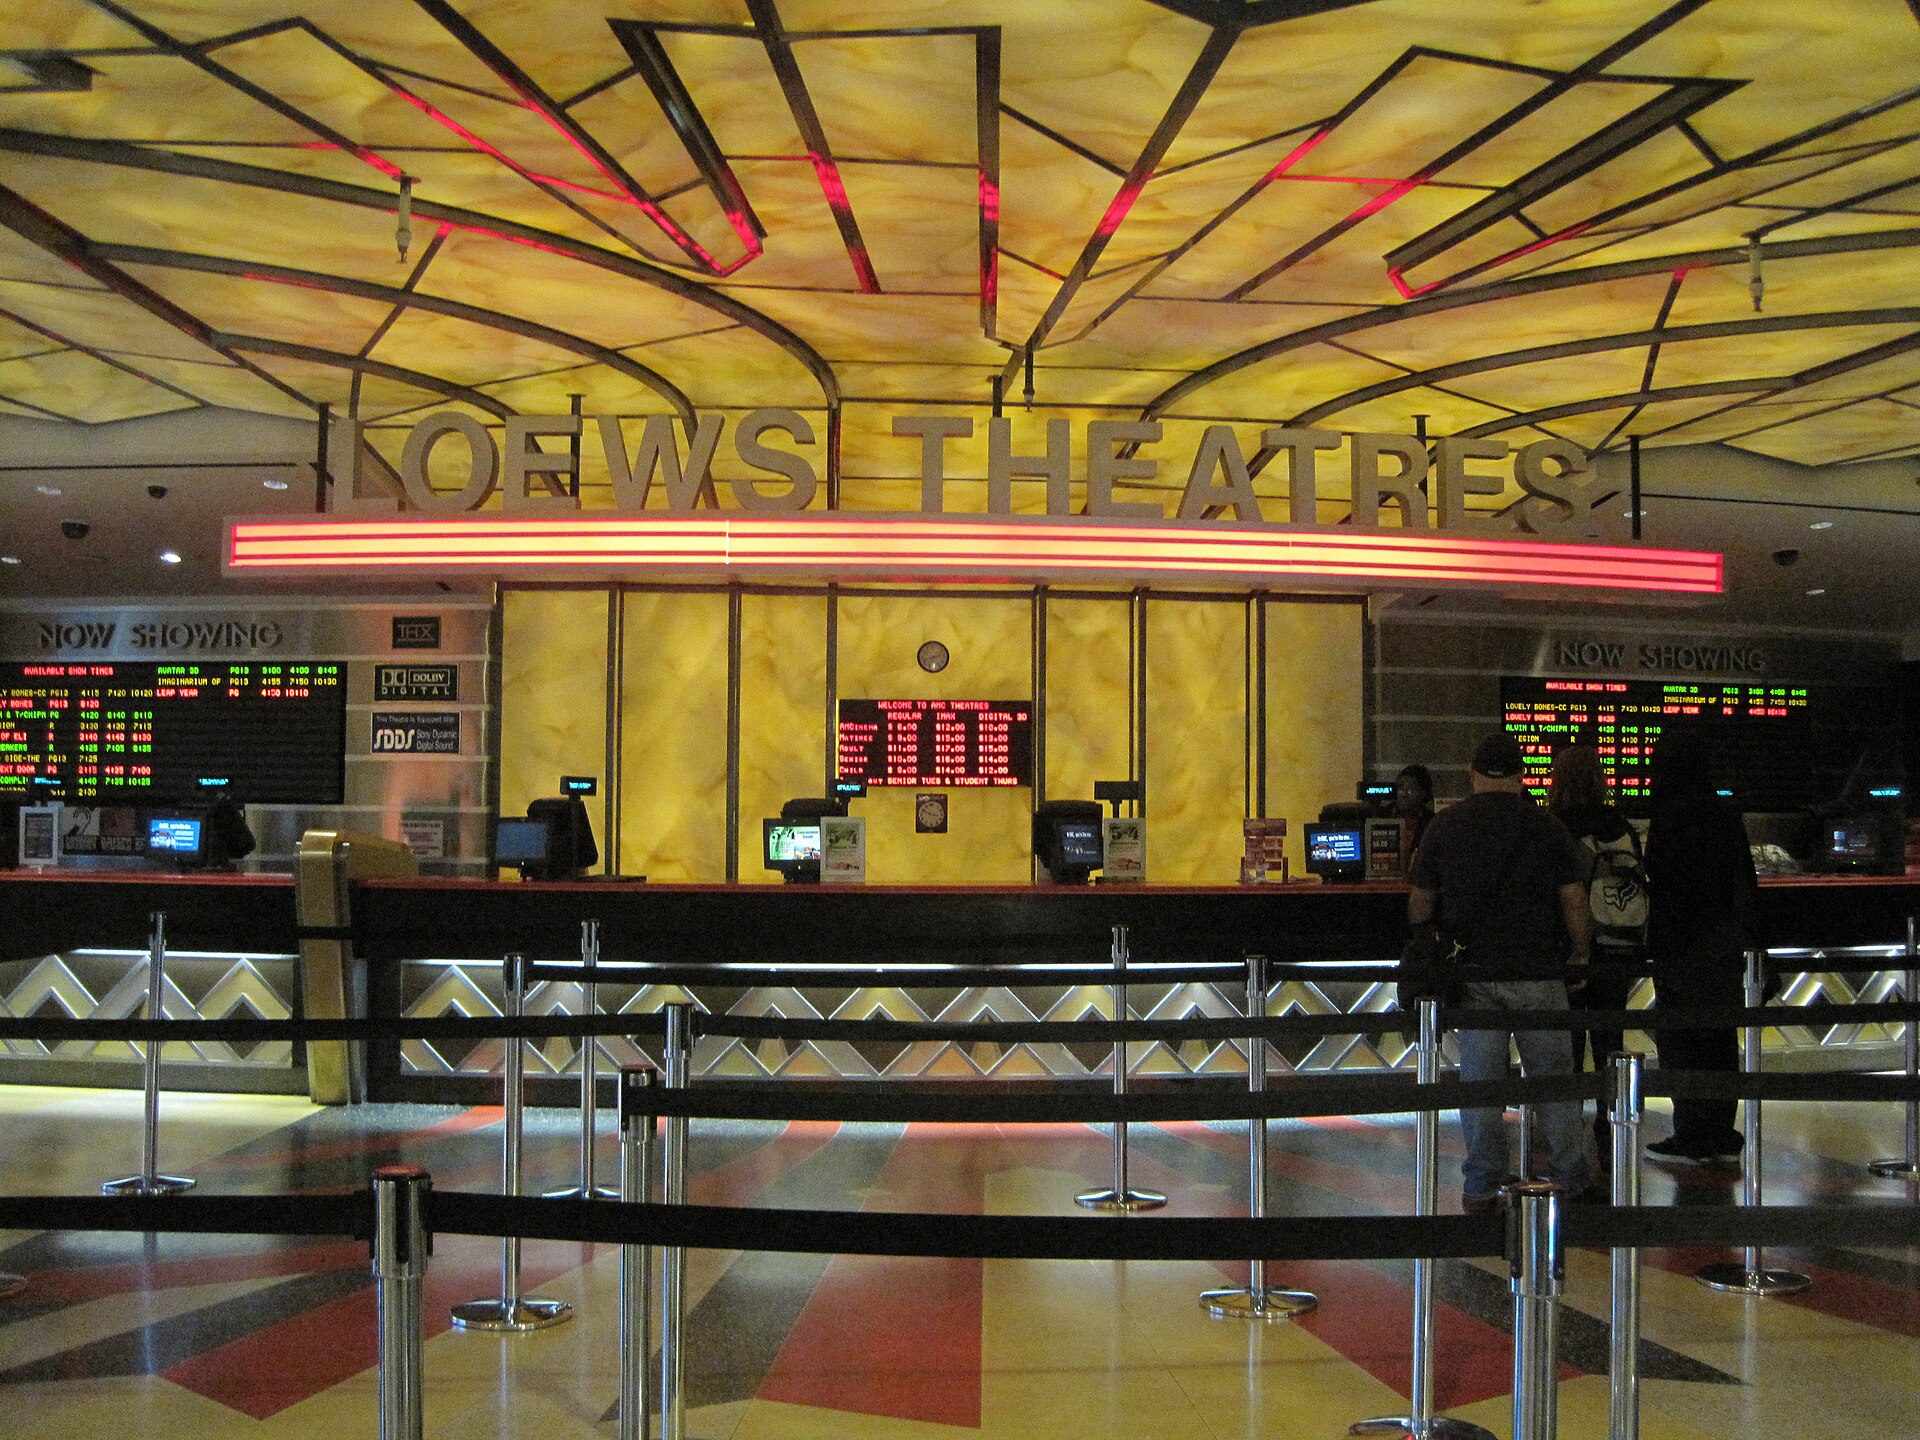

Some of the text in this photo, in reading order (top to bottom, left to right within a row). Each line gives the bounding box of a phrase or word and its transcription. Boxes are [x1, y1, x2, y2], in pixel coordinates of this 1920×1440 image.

[326, 407, 1599, 538] LOEWS THEATRES
[39, 621, 284, 649] NOW SHOWING
[397, 623, 436, 641] THX
[1555, 641, 1767, 672] NOW SHOWING
[24, 666, 114, 676] AVAILABLE SHOW TIMES
[157, 666, 185, 675] AVATAR
[229, 666, 250, 675] PG13
[289, 666, 310, 675] 4:00
[157, 677, 208, 686] IMAGINARIUM
[211, 677, 222, 686] OF
[229, 677, 249, 686] PG13
[412, 673, 445, 683] DOLBY
[381, 685, 450, 696] DIGITAL
[1546, 683, 1627, 692] AVAILABLE SHOW TIMES
[1663, 686, 1687, 694] AVATAR
[1722, 687, 1739, 695] PG13
[1748, 688, 1764, 696] 3:00
[1769, 688, 1786, 696] 4:00
[50, 689, 69, 698] PG13
[81, 689, 100, 698] 4:15
[156, 689, 176, 697] LEAP
[179, 689, 199, 697] YEAR
[228, 689, 240, 697] PG
[285, 689, 310, 697] 10:10
[49, 700, 69, 709] PG13
[877, 701, 990, 710] WELCOME TO AMC THEATRES
[1723, 697, 1739, 705] PG13
[1505, 703, 1661, 714] LOVELY BONES-CC PG13 4:15 7:20 10:20
[1663, 706, 1680, 714] LEAP
[49, 711, 60, 720] PG
[80, 711, 100, 720] 4:20
[887, 712, 1028, 722] REGULAR IMAX DIGITAL 3D
[1505, 713, 1532, 721] LOVELY
[1534, 714, 1556, 722] BONES
[1569, 715, 1588, 723] PG13
[978, 723, 1009, 731] $10.00
[1505, 724, 1528, 732] ALVIN
[1598, 725, 1615, 734] 4:20
[13, 733, 28, 742] ELI
[105, 733, 126, 742] 4:40
[373, 728, 415, 750] SDDS
[416, 729, 458, 740] Sony Dynamic
[935, 734, 966, 742] $15.00
[978, 734, 1009, 742] $13.00
[1513, 735, 1540, 743] EGION
[1598, 736, 1615, 744] 3:30
[1621, 736, 1638, 744] 4:30
[434, 740, 454, 750] Sound
[887, 744, 918, 753] $11.00
[935, 744, 966, 753] $17.00
[978, 744, 1009, 753] $15.00
[1538, 745, 1552, 754] ELI
[1598, 746, 1616, 754] 3:40
[1621, 746, 1639, 754] 4:40
[48, 754, 67, 763] PG13
[887, 755, 918, 764] $10.00
[978, 755, 1009, 764] $14.00
[47, 765, 58, 774] PG
[935, 766, 966, 774] $14.00
[978, 766, 1009, 774] $12.00
[78, 777, 98, 786] 4:40
[887, 777, 917, 785] SENIOR
[921, 777, 941, 785] TUES
[954, 777, 989, 785] STUDENT
[993, 777, 1018, 785] THURS
[1621, 778, 1640, 786] 4:35
